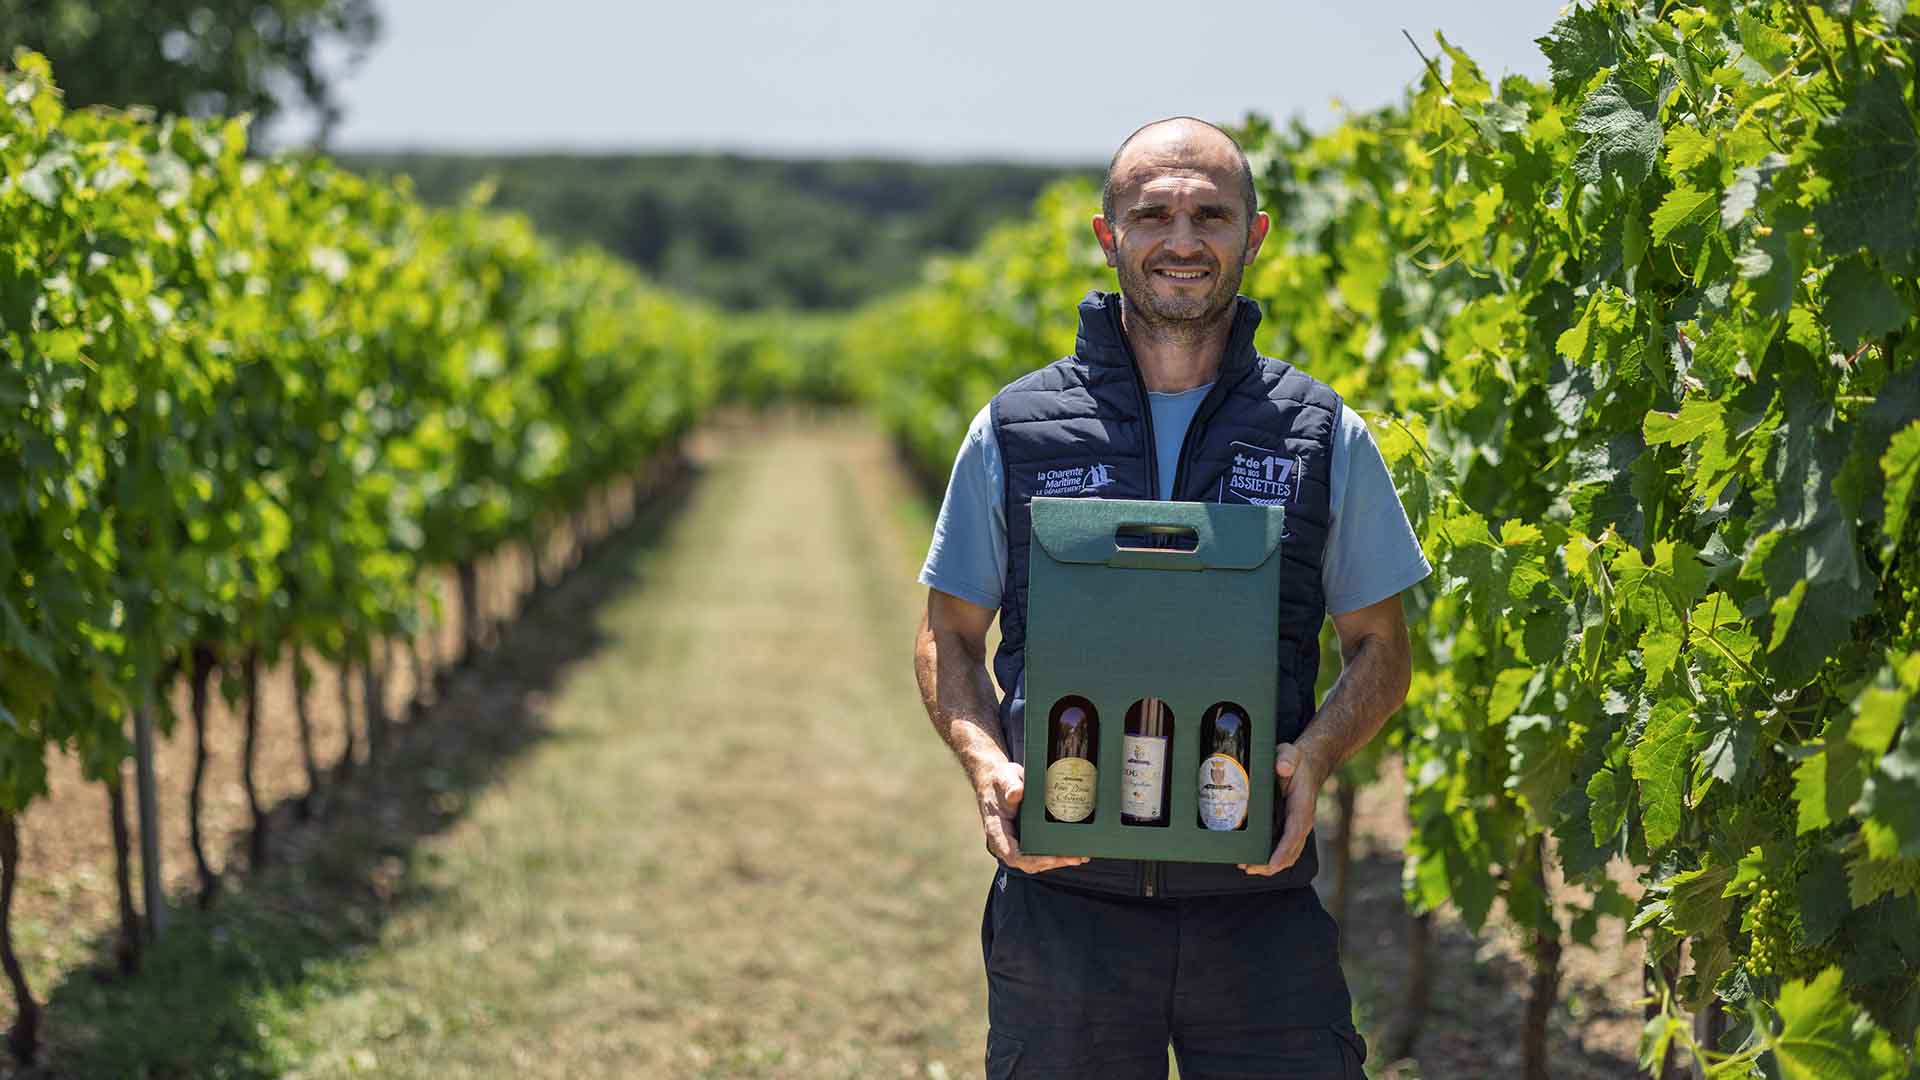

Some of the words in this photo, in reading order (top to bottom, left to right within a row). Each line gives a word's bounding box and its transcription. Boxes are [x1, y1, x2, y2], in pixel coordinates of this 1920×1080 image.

[1037, 472, 1046, 480] la
[1046, 467, 1084, 480] Charente
[1246, 457, 1260, 469] de
[1262, 455, 1294, 482] 17
[1045, 477, 1081, 488] Maritime
[1230, 474, 1291, 497] ASSIETTES
